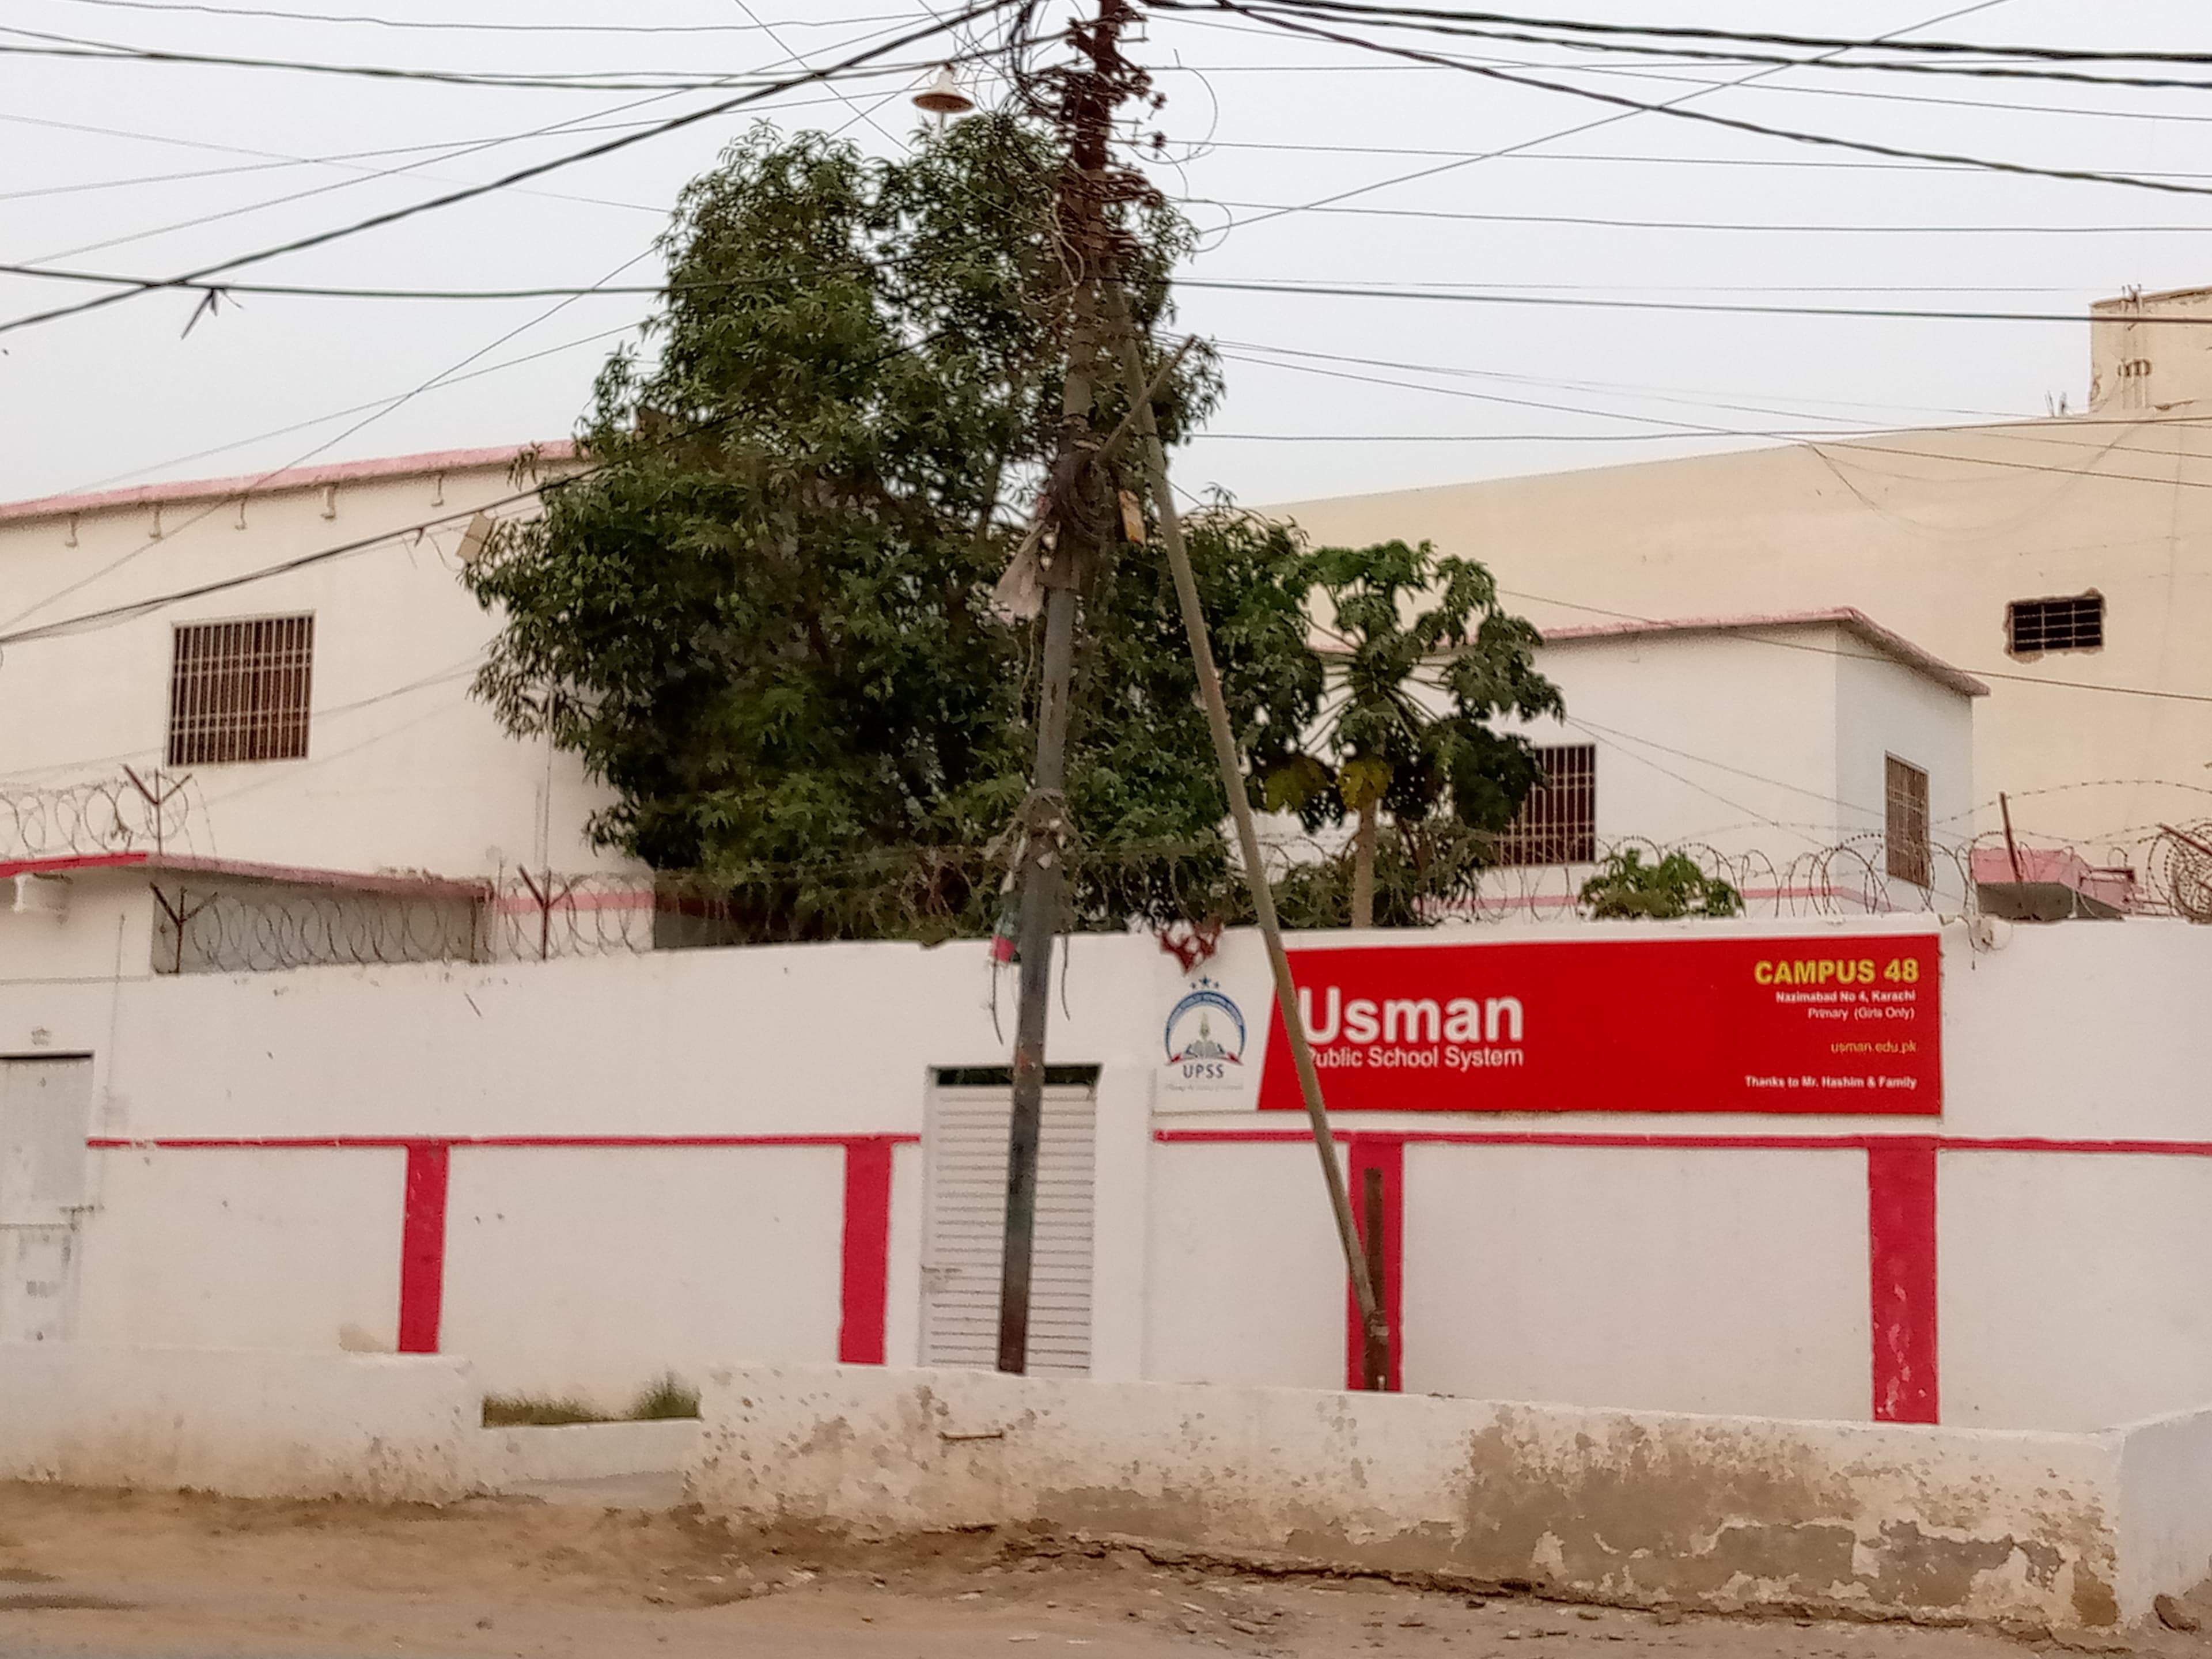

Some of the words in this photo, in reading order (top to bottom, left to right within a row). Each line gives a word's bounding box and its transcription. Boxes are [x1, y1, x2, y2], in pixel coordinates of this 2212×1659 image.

[1755, 959, 1876, 984] CAMPUS
[1883, 958, 1919, 983] 48
[1775, 990, 1838, 1003] Nazimabad
[1839, 990, 1856, 1002] No
[1871, 989, 1916, 1002] Karachi
[1298, 986, 1524, 1044] Usman
[1808, 1007, 1849, 1022] Primary
[1854, 1006, 1883, 1021] (Girls
[1885, 1006, 1915, 1021] Only)
[1831, 1039, 1916, 1054] usman.edu.pk
[1367, 1045, 1439, 1068] School
[1444, 1046, 1524, 1072] System
[1183, 1064, 1224, 1079] UPSS
[1745, 1075, 1785, 1088] Thanks
[1787, 1076, 1800, 1088] to
[1801, 1075, 1819, 1088] Mr.
[1821, 1075, 1865, 1088] Hashim
[1866, 1075, 1876, 1088] &
[1878, 1075, 1917, 1090] Family
